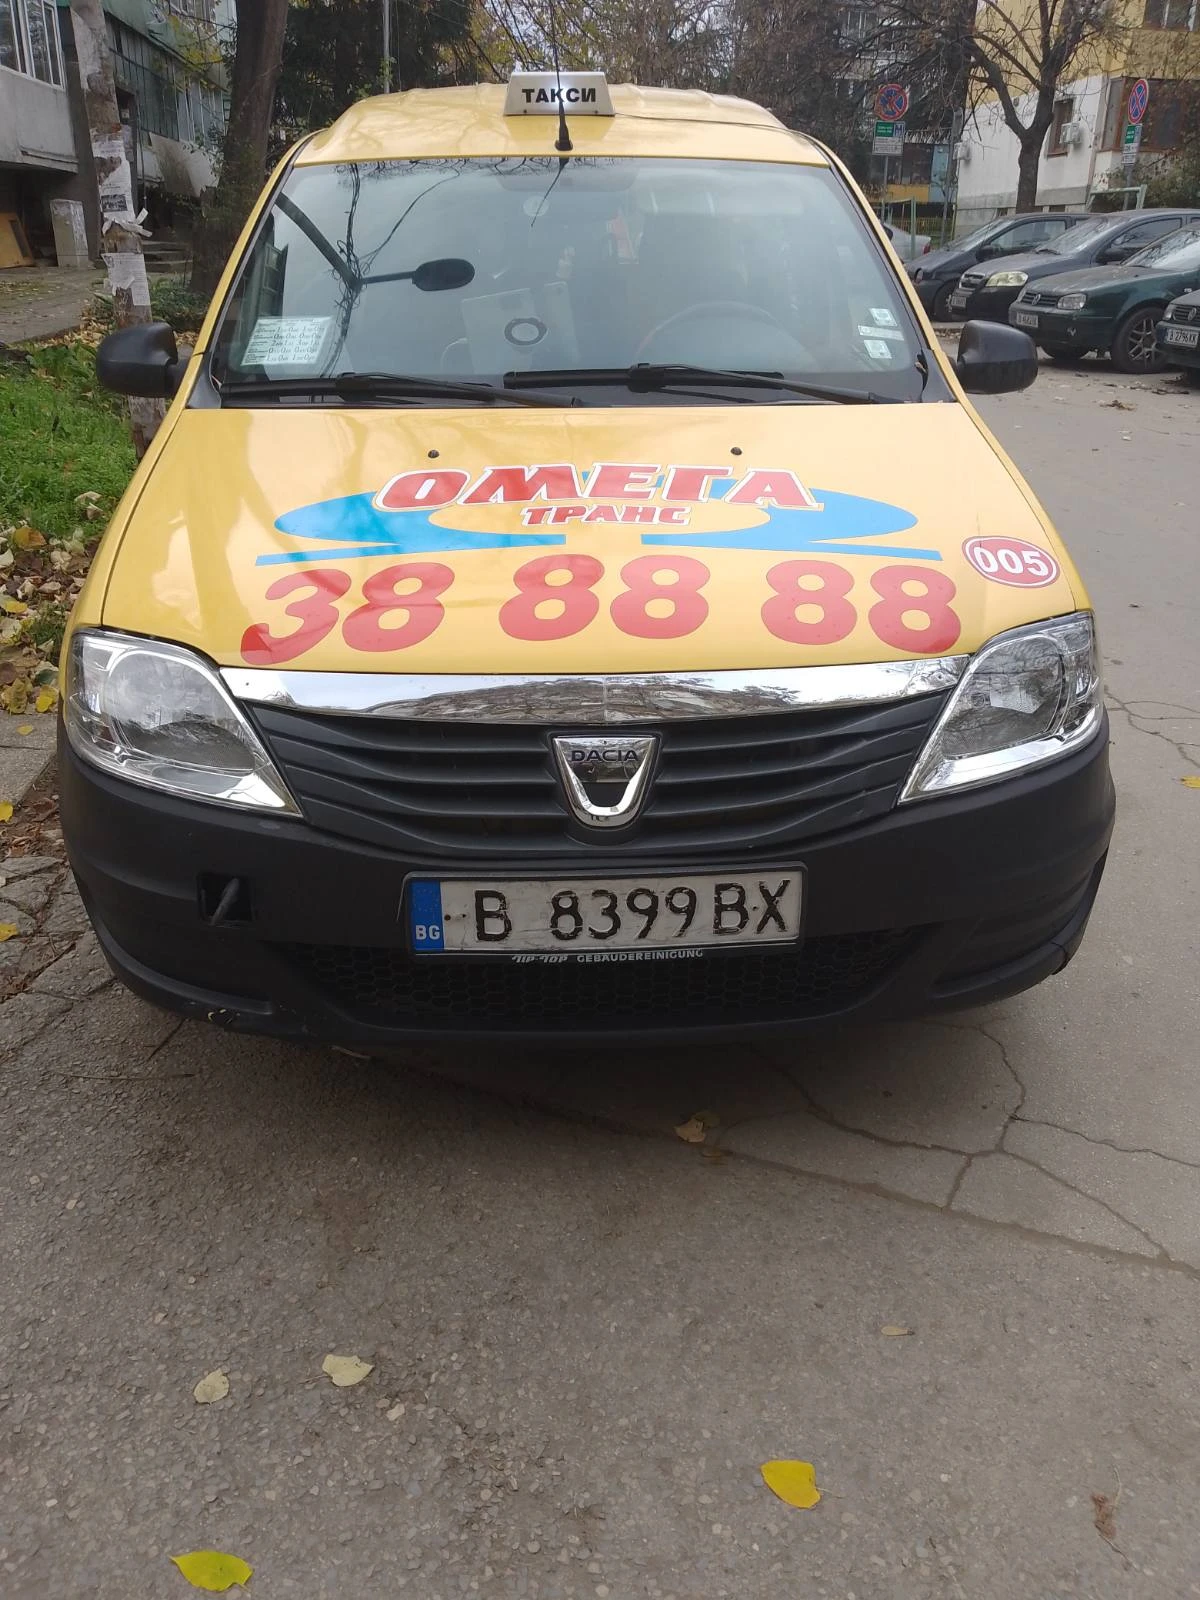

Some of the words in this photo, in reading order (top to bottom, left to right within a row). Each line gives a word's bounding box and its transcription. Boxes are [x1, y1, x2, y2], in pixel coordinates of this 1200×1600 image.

[522, 87, 597, 103] ТАКСИ
[371, 462, 824, 512] ОМЕГА
[521, 504, 691, 527] ТРАНС
[972, 546, 1049, 577] 005
[240, 561, 455, 666] 38
[498, 554, 711, 641] 88
[761, 560, 961, 654] 88
[571, 750, 639, 762] DACIA
[475, 889, 513, 942] B
[551, 887, 698, 941] 8399
[713, 879, 791, 935] BX
[415, 924, 441, 940] BG
